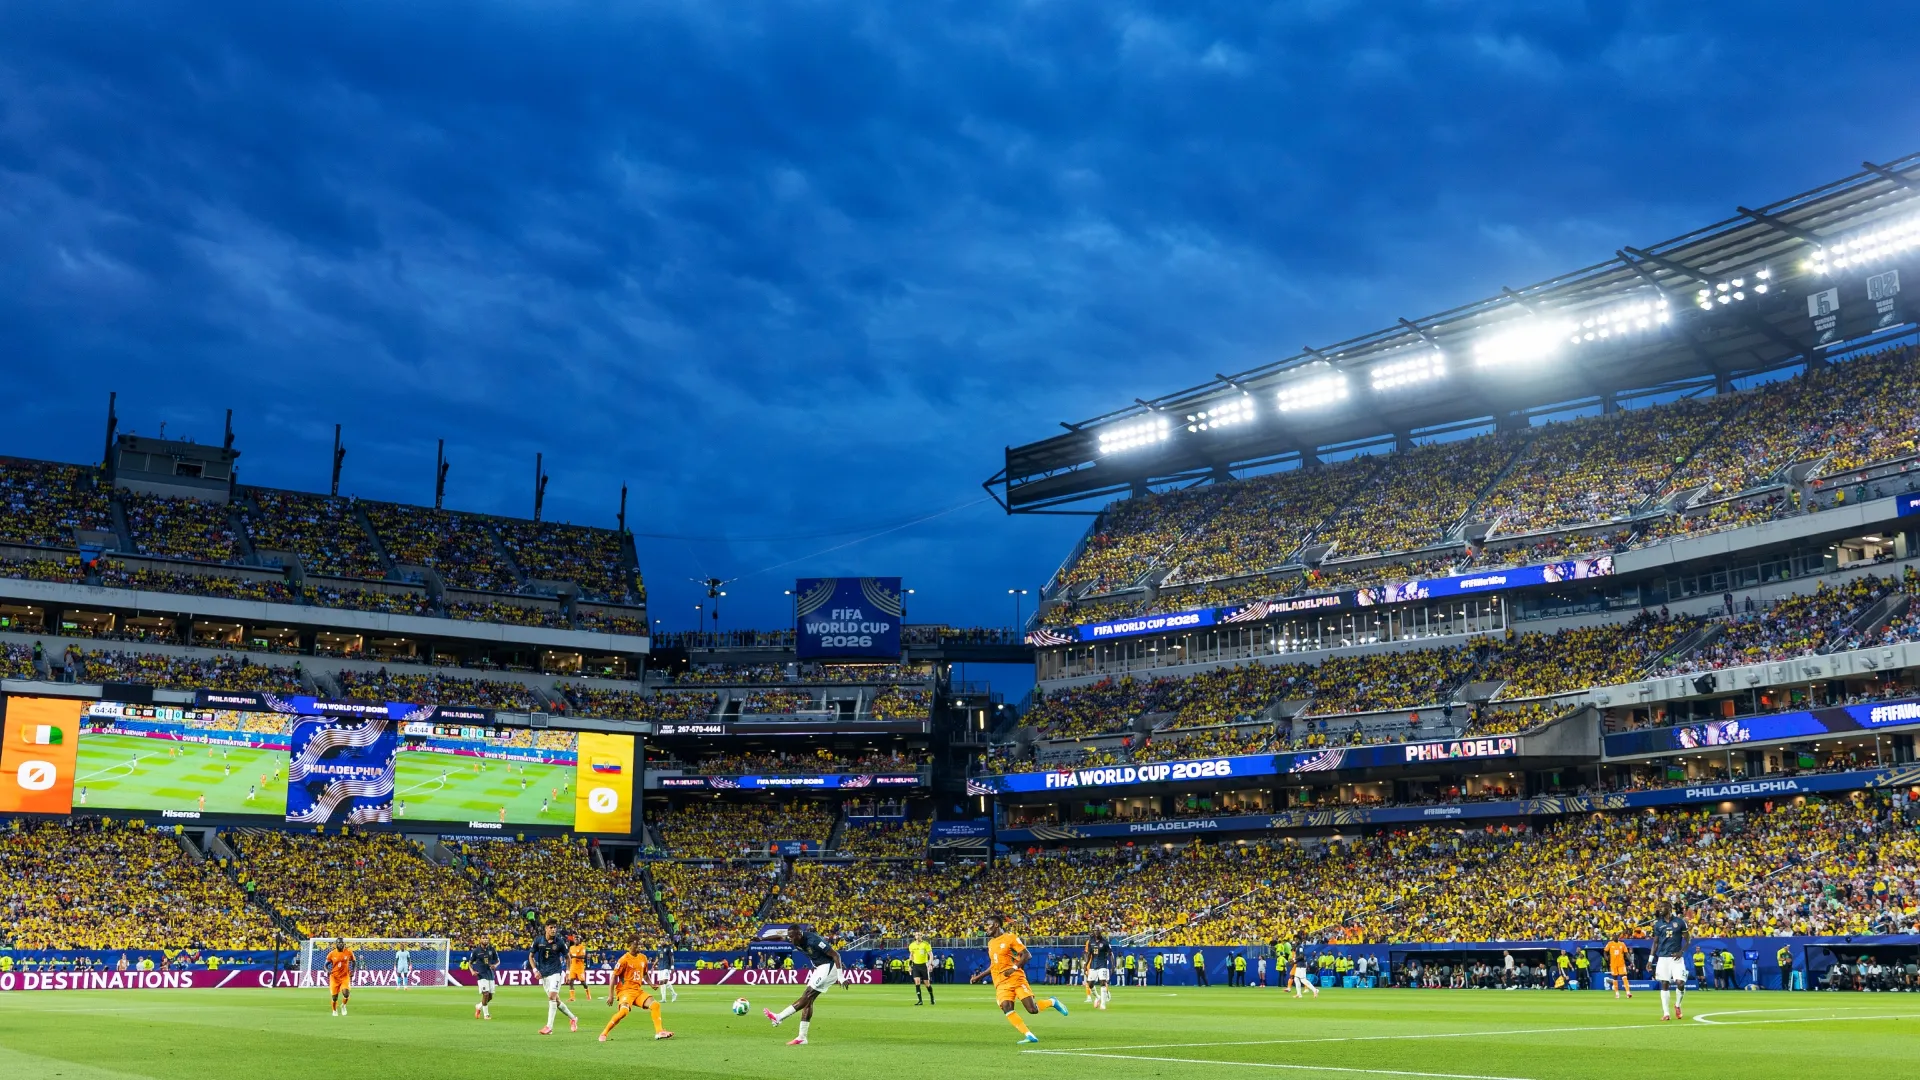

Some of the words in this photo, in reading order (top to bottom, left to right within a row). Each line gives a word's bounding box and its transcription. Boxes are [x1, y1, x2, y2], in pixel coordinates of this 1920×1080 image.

[1870, 272, 1897, 300] 92
[1817, 292, 1830, 316] 5
[1460, 576, 1506, 588] #FIFAWorldCup
[1269, 596, 1340, 614] PHILADELPHIA
[832, 609, 862, 620] FIFA
[806, 622, 858, 634] WORLD
[861, 622, 889, 634] CUP
[1094, 626, 1113, 636] FIFA
[1114, 621, 1146, 634] WORLD
[1147, 618, 1166, 630] CUP
[1167, 614, 1198, 627] 2026
[821, 636, 872, 647] 2026
[313, 702, 327, 710] FIFA
[303, 764, 383, 776] PHILADELPHIA
[1046, 772, 1077, 788] FIFA
[1080, 767, 1139, 786] WORLD
[1138, 764, 1170, 781] CUP
[1172, 760, 1230, 779] 2026
[1686, 779, 1797, 798] PHILADELPHIA
[162, 809, 201, 818] Hisense
[469, 821, 502, 829] Hisense
[1130, 819, 1217, 832] PHILADELPHIA
[1164, 953, 1187, 964] FIFA
[24, 971, 193, 990] DESTINATIONS
[258, 970, 332, 988] QATAR
[496, 970, 532, 985] VER
[634, 971, 640, 981] 15
[744, 970, 798, 985] QATAR
[804, 970, 871, 984] AAYS
